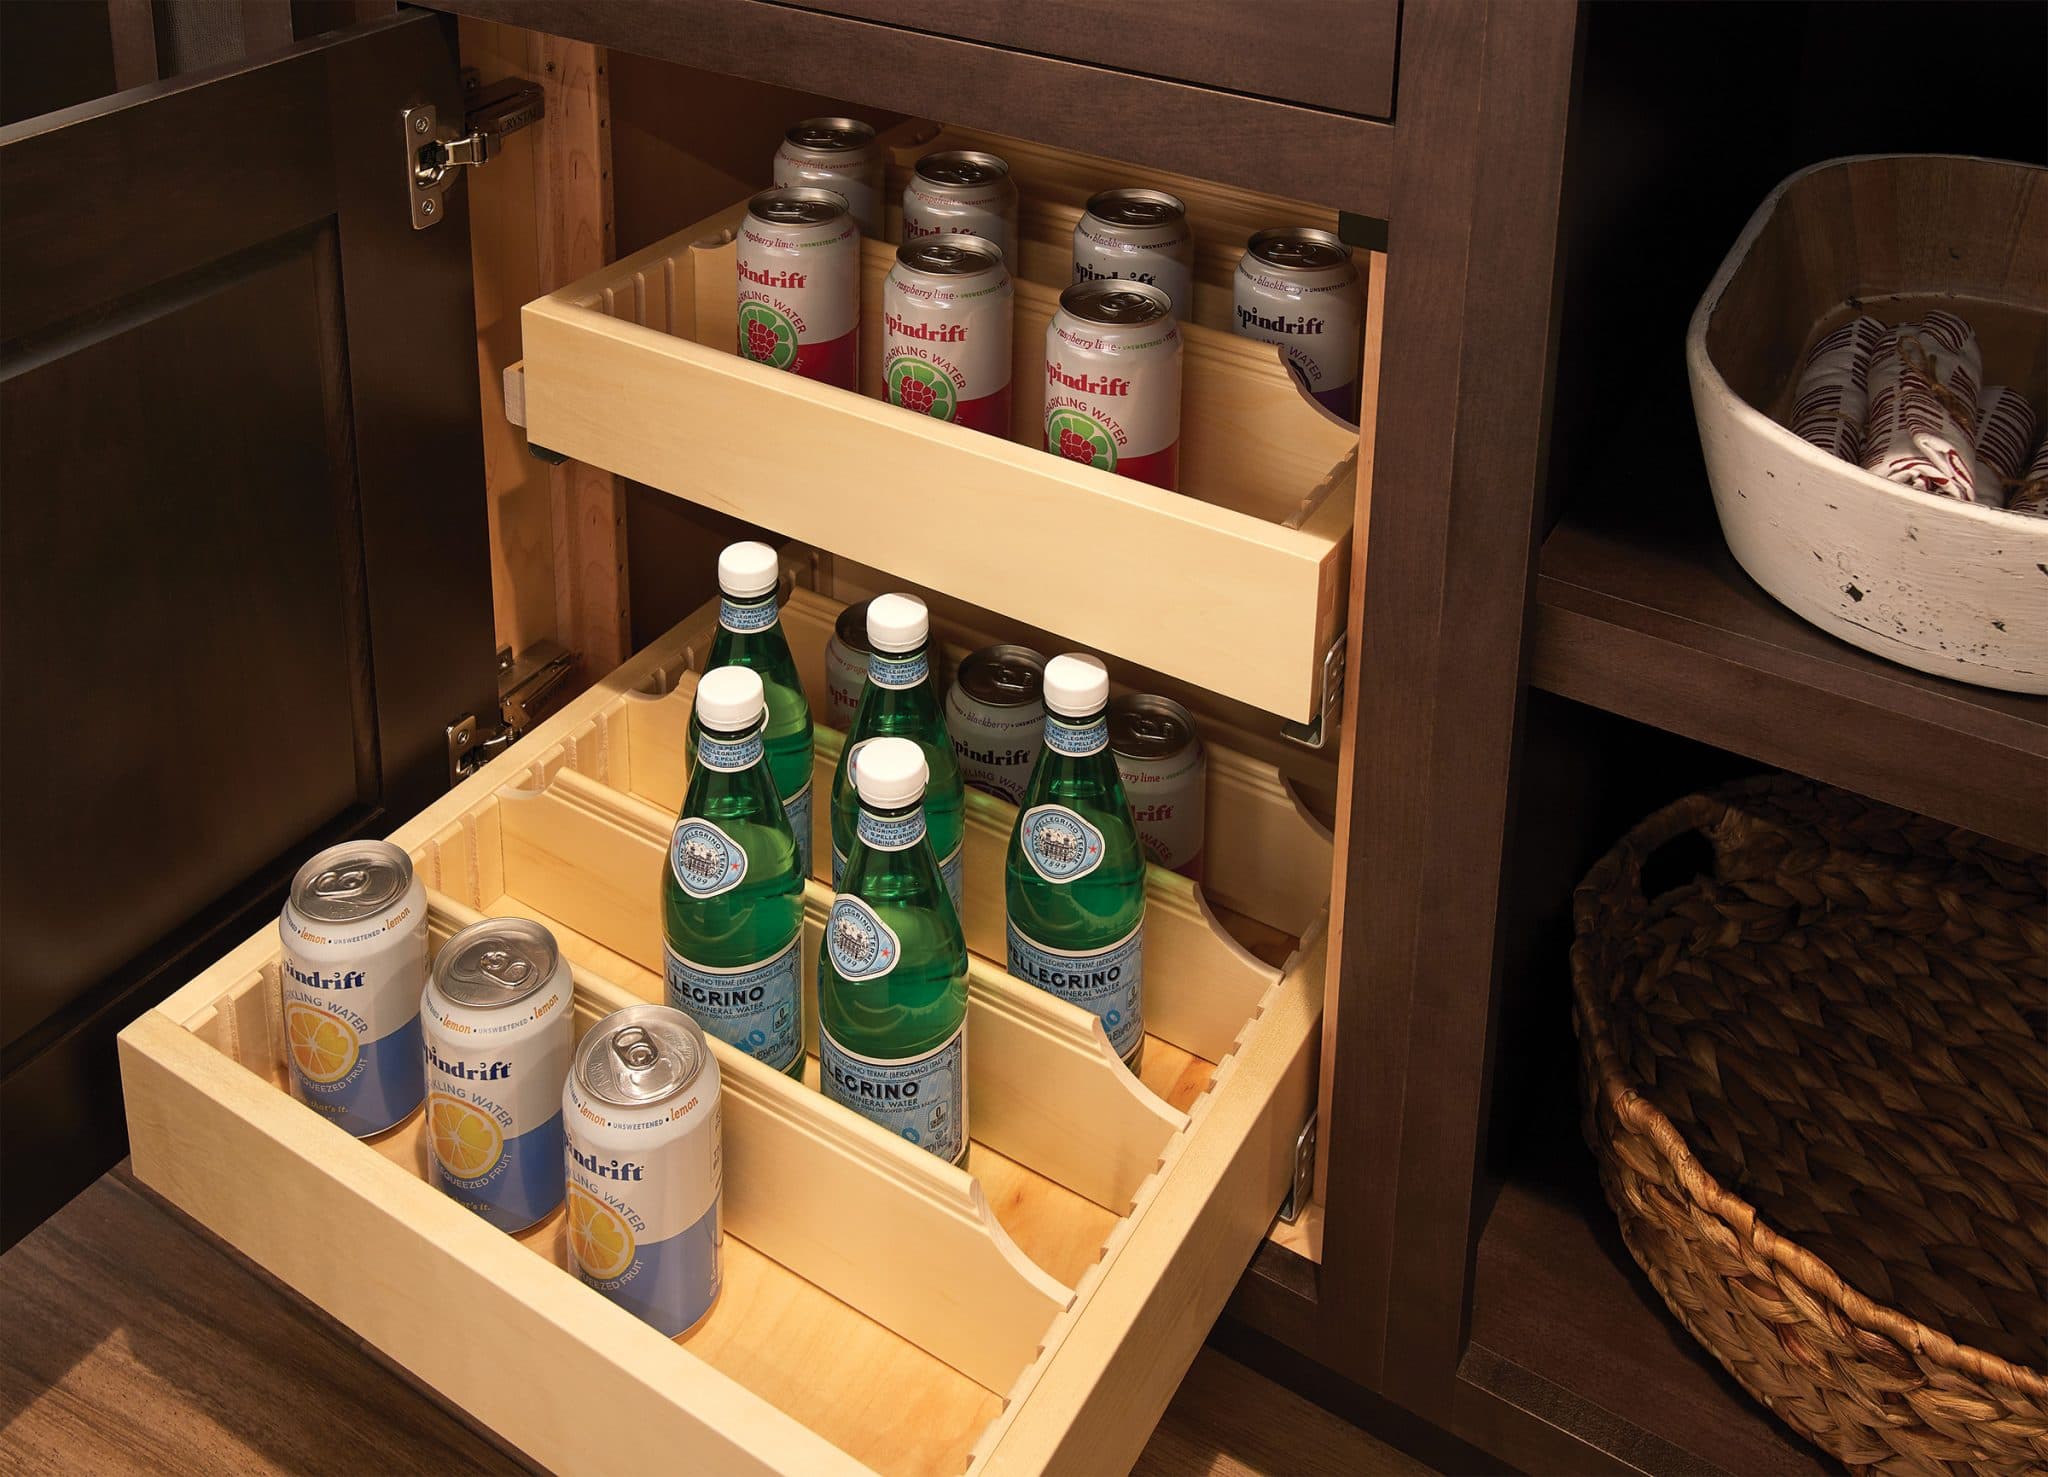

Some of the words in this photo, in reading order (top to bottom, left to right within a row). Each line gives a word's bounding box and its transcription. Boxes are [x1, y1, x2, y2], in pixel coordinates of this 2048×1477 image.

[933, 289, 954, 300] lime
[774, 298, 807, 335] WATER
[1237, 304, 1325, 335] spindrift
[932, 354, 966, 389] WATER
[1289, 346, 1323, 381] WATER
[1091, 406, 1128, 446] WATER
[1140, 772, 1161, 783] lime
[1035, 816, 1079, 835] PELLEGRINO
[300, 926, 326, 945] lemon
[333, 929, 381, 945] UNSWEETENED
[386, 906, 411, 930] lemon
[862, 935, 876, 964] TERME
[284, 958, 366, 991] indrift
[1055, 989, 1093, 998] MINERAL
[1095, 981, 1121, 996] WATER
[328, 1001, 368, 1034] WATER
[442, 1014, 471, 1034] lemon
[478, 1018, 529, 1035] UNSWEETENED
[533, 993, 559, 1019] lemon
[697, 1003, 733, 1015] MINERAL
[735, 1001, 764, 1014] WATER
[348, 1057, 369, 1083] FRUIT
[866, 1069, 888, 1079] TERME
[472, 1093, 513, 1128] WATER
[580, 1102, 606, 1127] lemon
[613, 1119, 664, 1130] UNSWEETENED
[670, 1096, 699, 1121] lemon
[849, 1093, 885, 1108] MINERAL
[888, 1097, 918, 1109] WATER
[490, 1152, 512, 1180] FRUIT
[569, 1138, 644, 1181] ndrift
[604, 1191, 646, 1233] WATER
[620, 1259, 645, 1286] FRUIT
